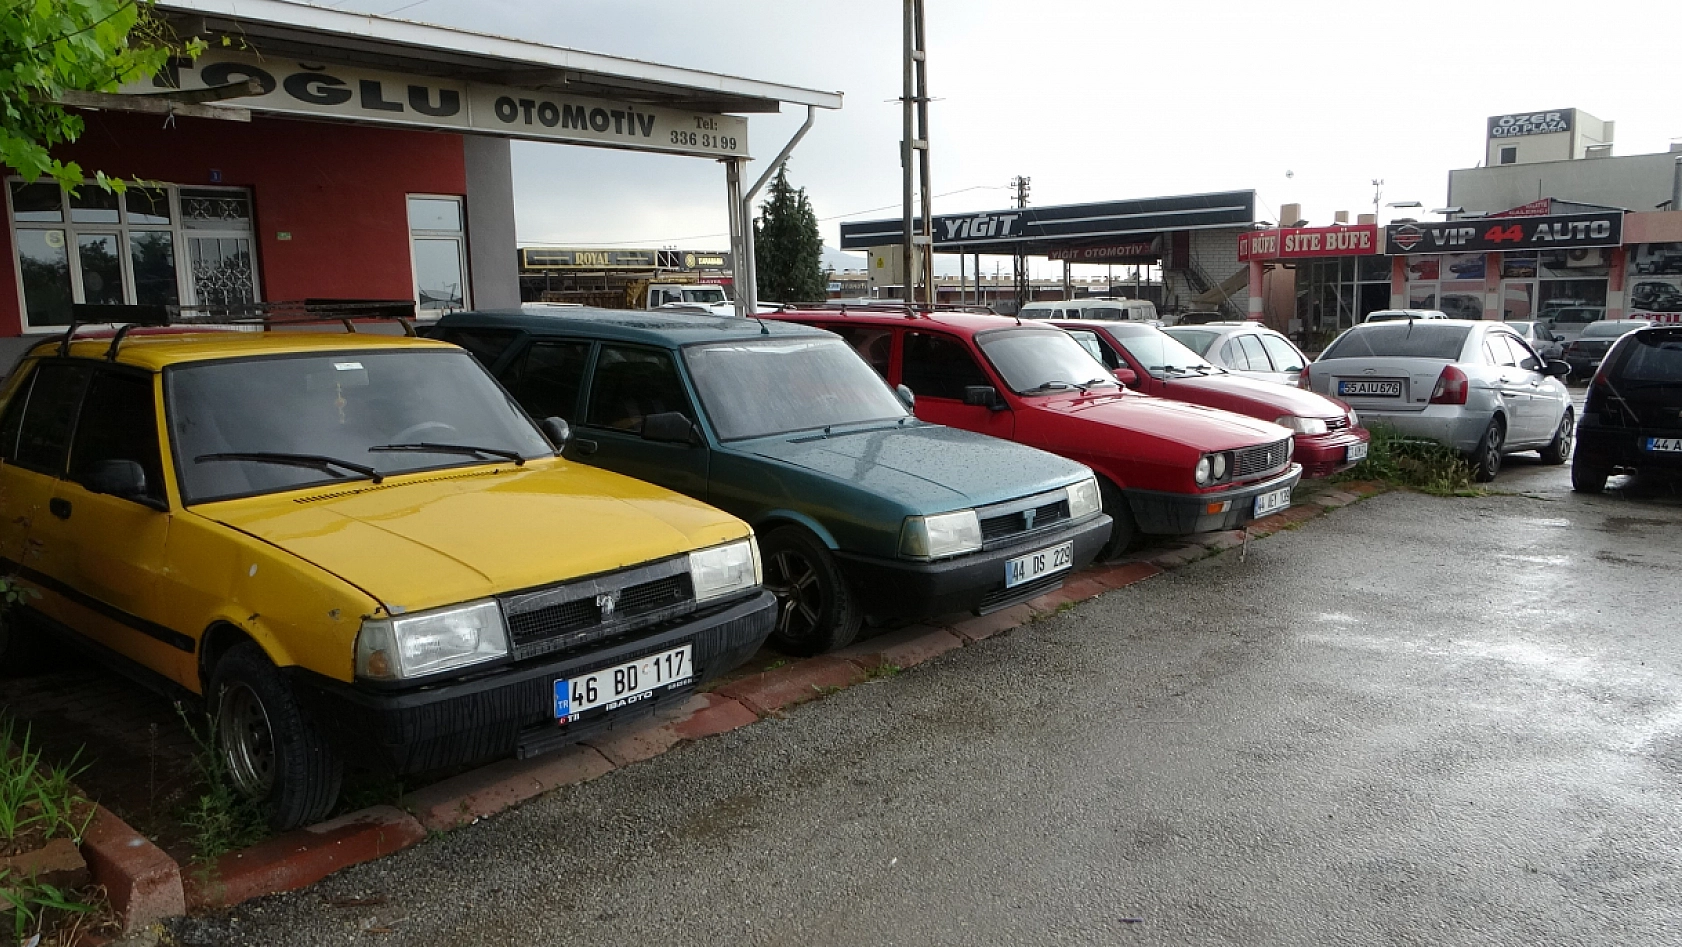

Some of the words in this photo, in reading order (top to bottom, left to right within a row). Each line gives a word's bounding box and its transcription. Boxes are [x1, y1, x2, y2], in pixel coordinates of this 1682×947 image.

[494, 96, 656, 138] OTOMOTİV
[693, 116, 718, 131] Tel:
[1492, 125, 1519, 135] OTO
[1523, 120, 1567, 132] PLAZA
[1499, 112, 1561, 126] ÖZER
[670, 130, 697, 146] 336
[702, 133, 737, 150] 3199
[1285, 229, 1320, 252] SİTE
[1325, 227, 1371, 251] BÜFE
[1431, 227, 1476, 246] VIP
[1484, 225, 1524, 243] 44
[1531, 220, 1610, 241] AUTO
[1252, 233, 1276, 255] BÜFE
[575, 252, 609, 266] ROYAL
[1013, 560, 1025, 581] 44
[1033, 554, 1045, 574] DS
[571, 676, 598, 706] 46
[614, 664, 638, 696] BD
[653, 650, 685, 683] 117
[557, 699, 569, 709] TR
